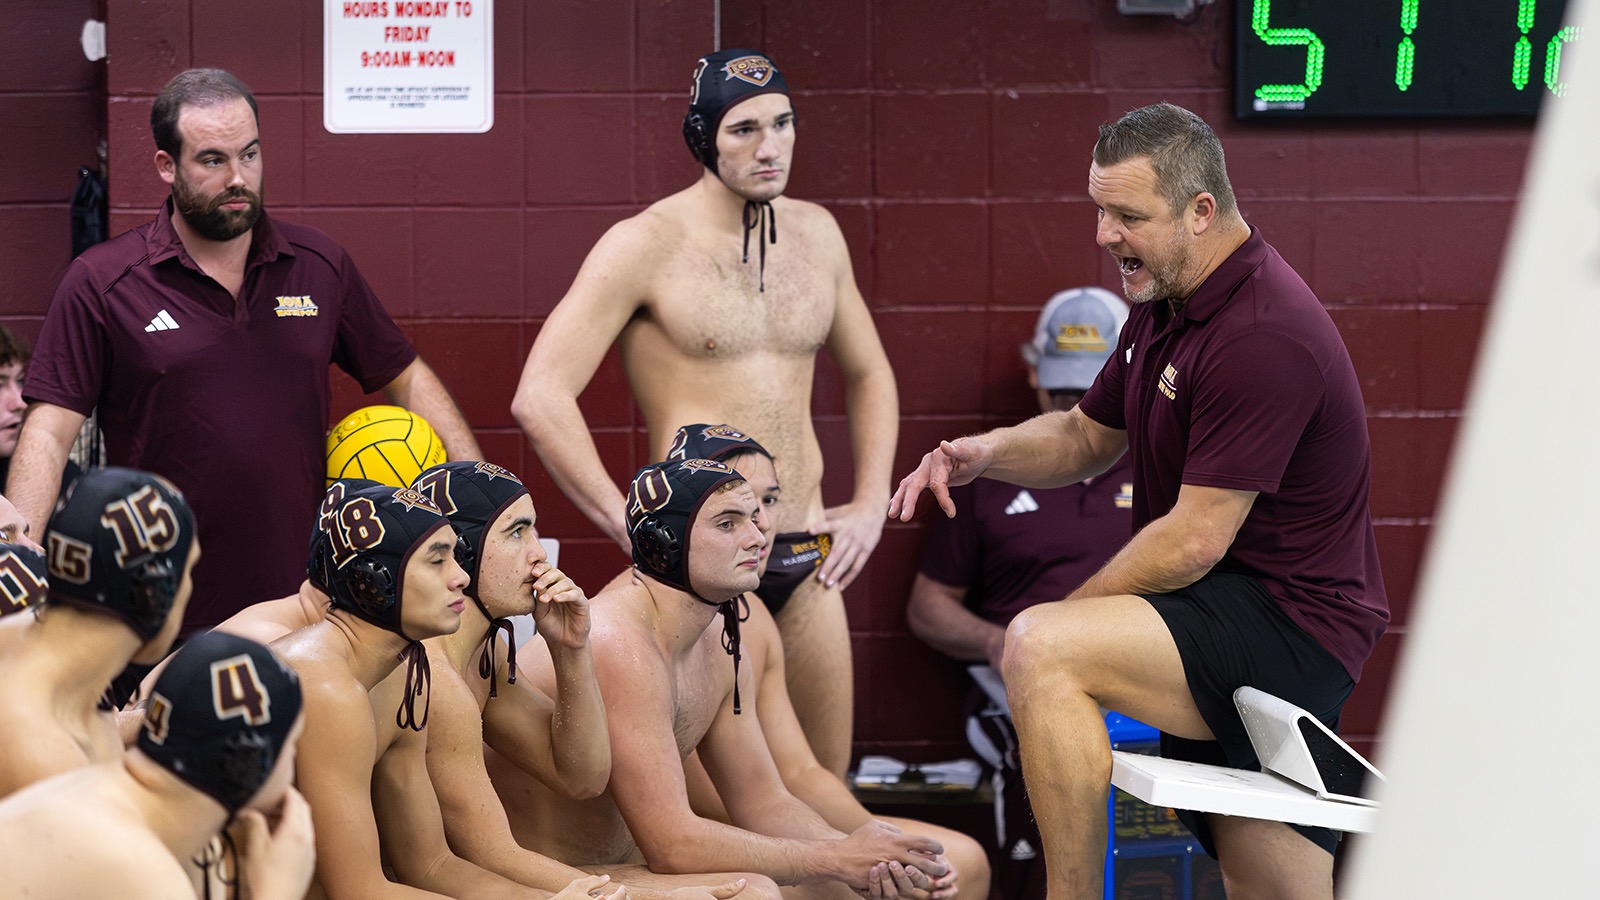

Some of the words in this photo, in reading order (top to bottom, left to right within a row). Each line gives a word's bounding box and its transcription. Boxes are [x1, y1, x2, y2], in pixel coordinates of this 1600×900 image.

[343, 1, 388, 18] HOURS
[394, 1, 448, 18] MONDAY
[455, 1, 472, 18] TO
[384, 26, 431, 43] FRIDAY
[361, 51, 456, 68] 9:00AM-NOON
[275, 295, 317, 307] IONA
[100, 484, 181, 570] 15
[327, 496, 386, 571] 18
[47, 529, 93, 585] 15
[210, 652, 272, 727] 4
[143, 690, 173, 746] 4
